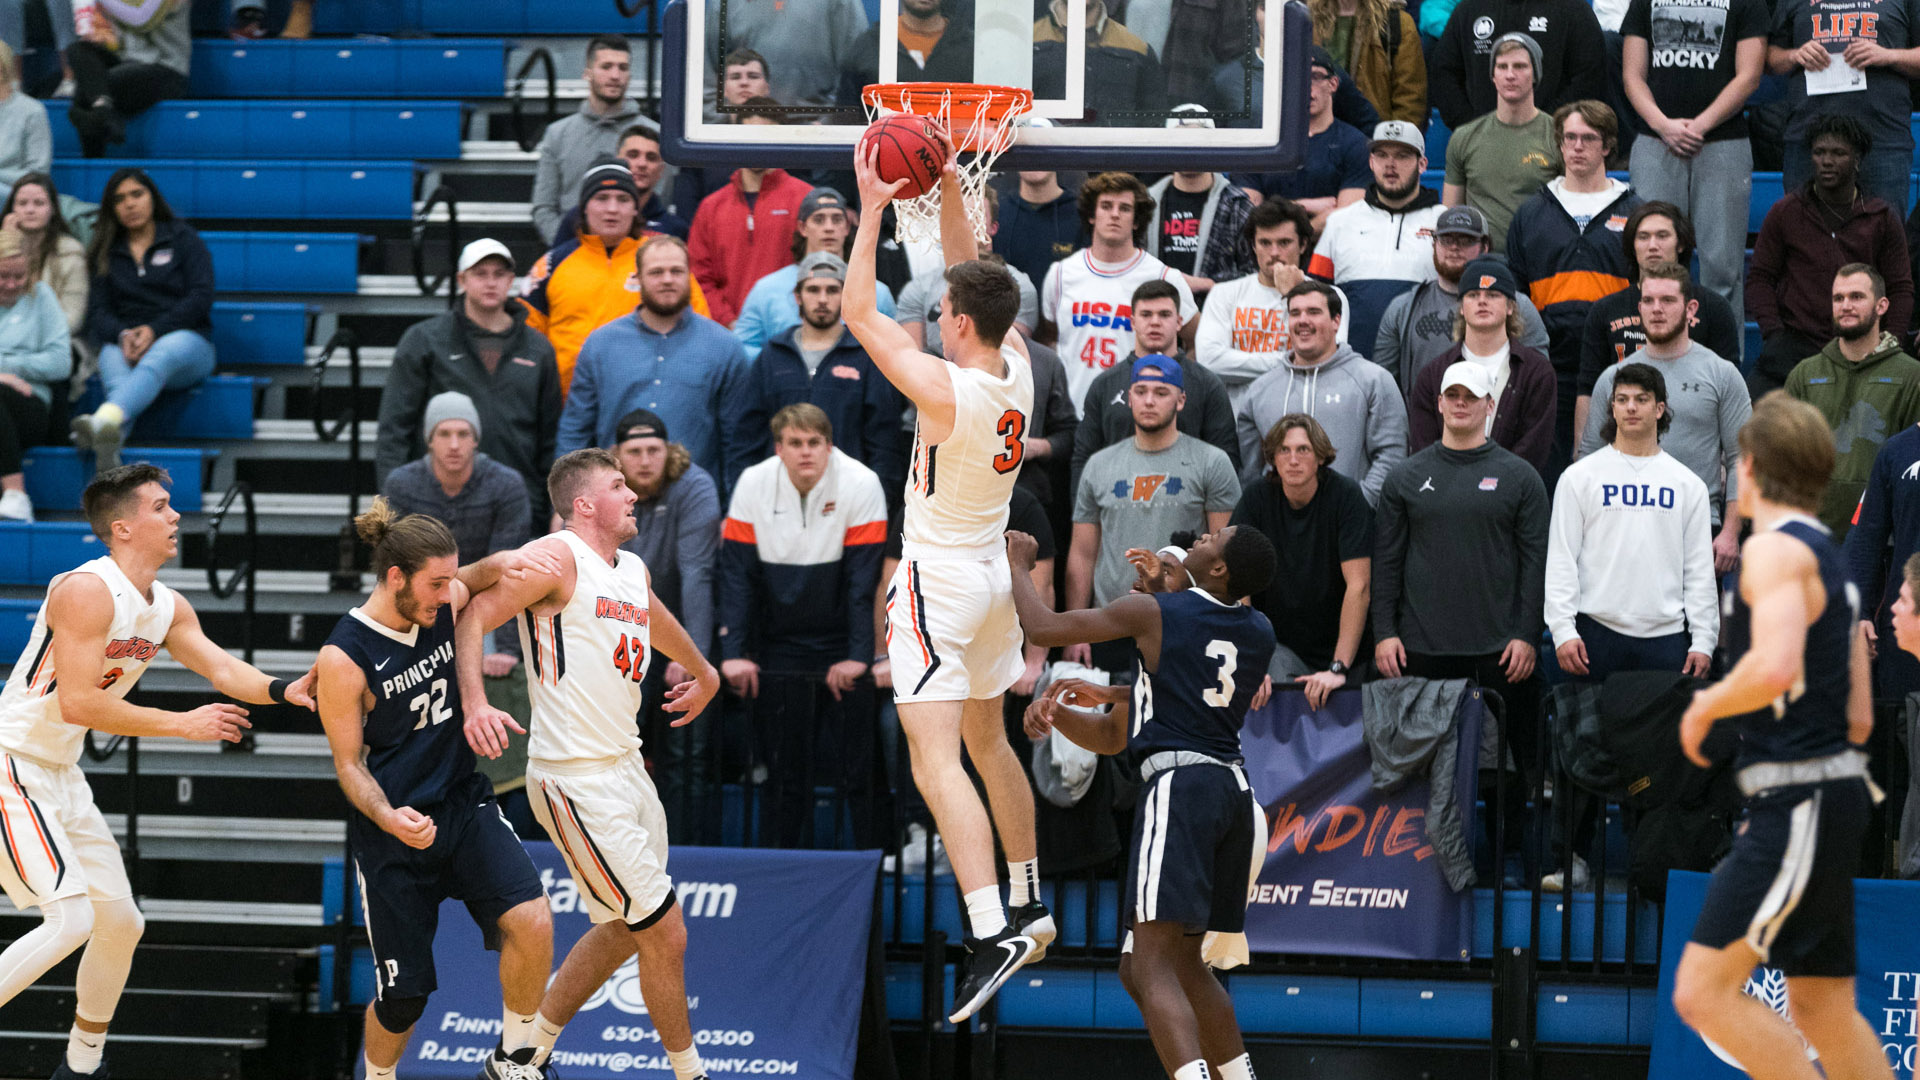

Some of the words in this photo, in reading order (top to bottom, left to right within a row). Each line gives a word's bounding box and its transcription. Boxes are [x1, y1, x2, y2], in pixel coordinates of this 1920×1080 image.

[1811, 11, 1879, 39] LIFE
[1652, 48, 1720, 70] ROCKY
[1072, 301, 1133, 332] USA
[1080, 336, 1117, 369] 45
[992, 409, 1026, 475] 3
[1132, 472, 1169, 503] W
[1602, 484, 1675, 509] POLO
[613, 632, 644, 683] 42
[1202, 639, 1239, 708] 3
[1248, 884, 1304, 904] DENT
[384, 959, 399, 987] P
